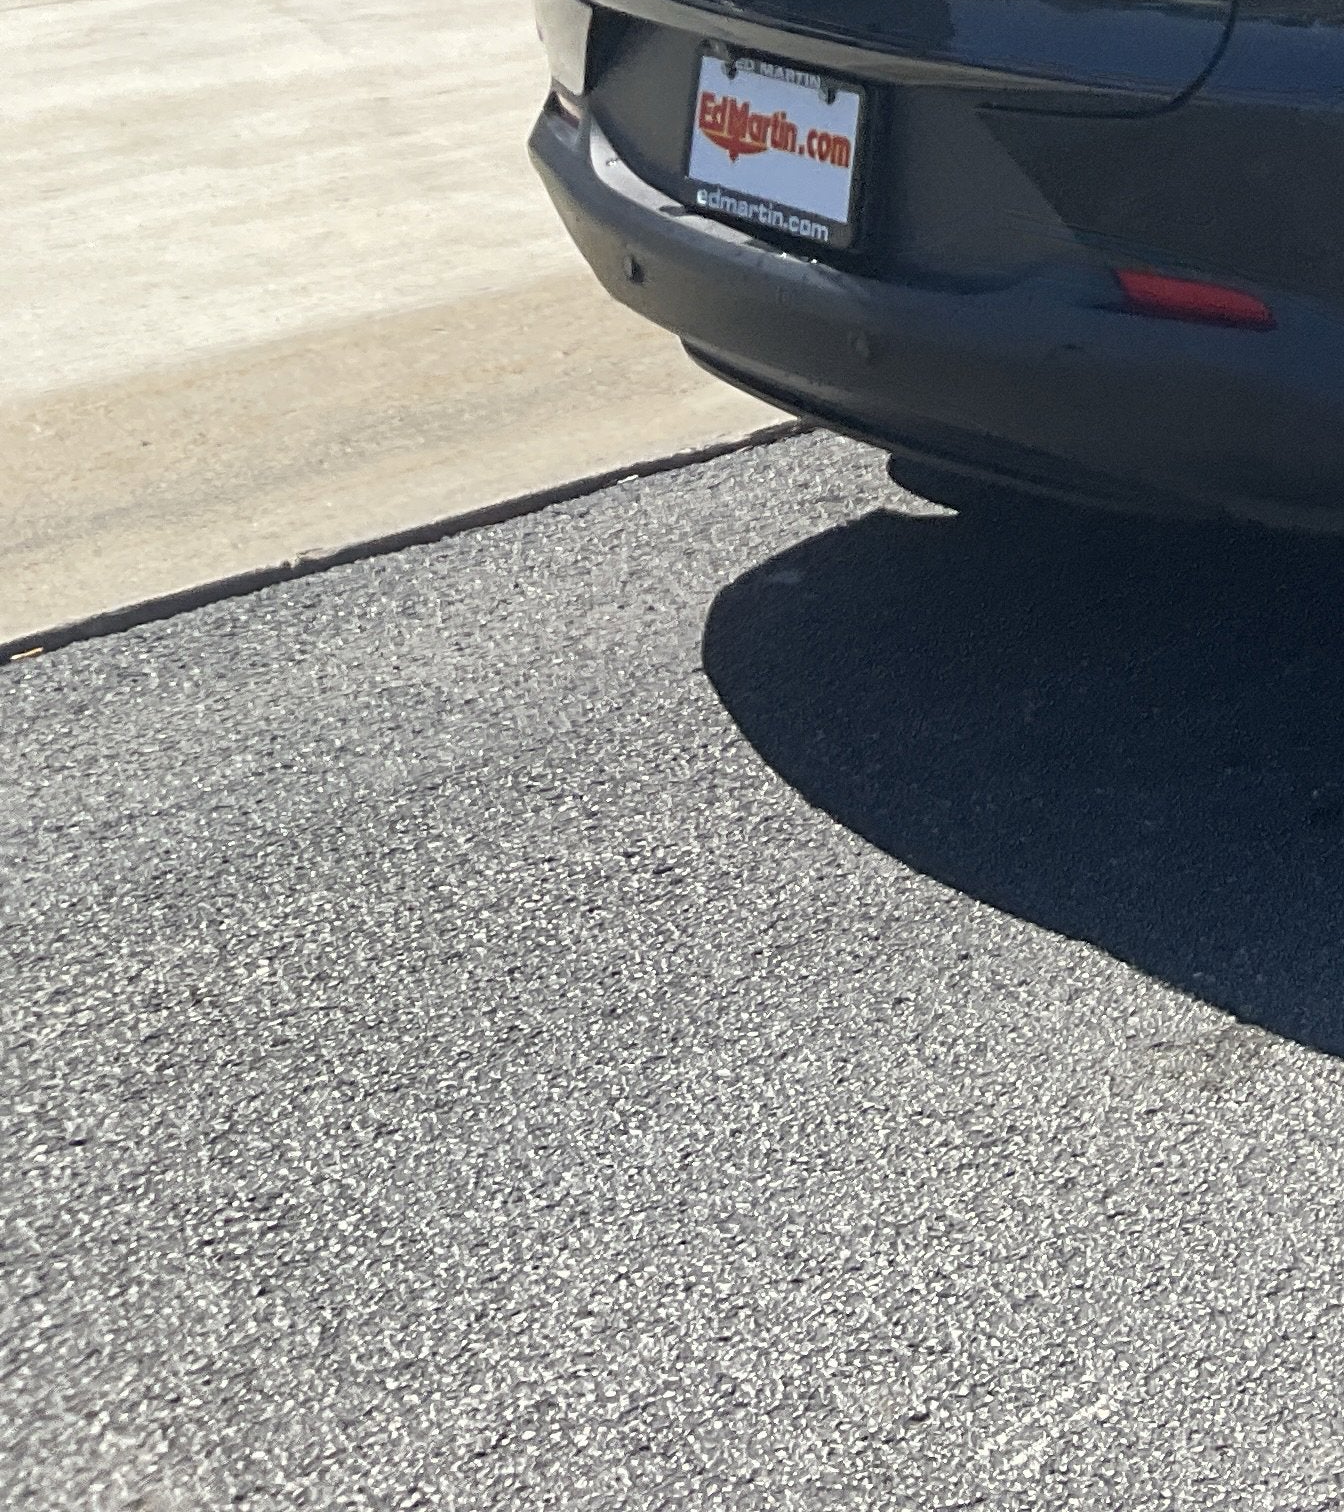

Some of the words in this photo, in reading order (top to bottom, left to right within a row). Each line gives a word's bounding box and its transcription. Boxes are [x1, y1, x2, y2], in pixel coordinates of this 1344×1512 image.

[735, 57, 755, 73] ED
[759, 61, 821, 88] MARTIN
[699, 90, 851, 169] EdMartin.com
[696, 188, 829, 242] edmartin.com
